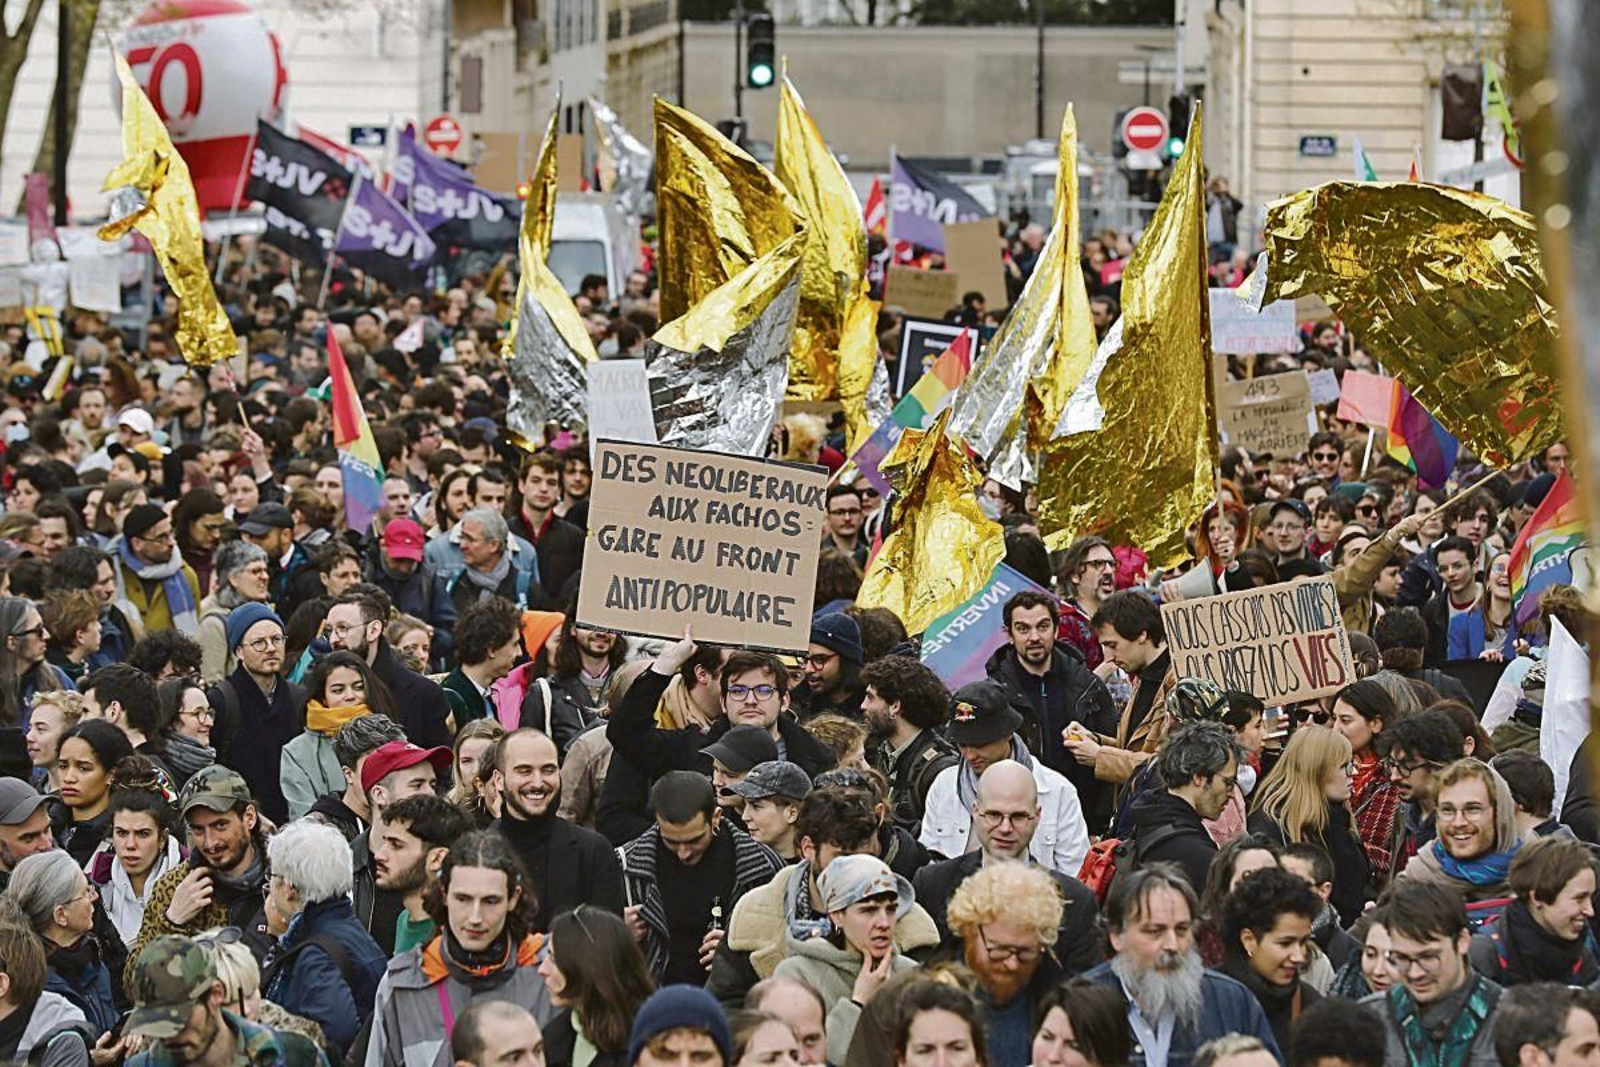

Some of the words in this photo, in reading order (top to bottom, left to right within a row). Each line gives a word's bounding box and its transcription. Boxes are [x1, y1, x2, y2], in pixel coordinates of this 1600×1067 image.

[1245, 379, 1280, 396] 493
[601, 451, 657, 483] DES
[665, 461, 826, 512] NEOLIBERAUX
[648, 495, 699, 523] AUX
[598, 525, 662, 558] GARE
[671, 536, 705, 563] AU
[716, 542, 800, 576] FRONT
[605, 575, 795, 627] ANTIPOPULAIRE
[1165, 603, 1209, 653] NOUS
[1210, 593, 1271, 646] CASSONS
[1270, 592, 1297, 636] DES
[1257, 639, 1300, 700] NOS
[1292, 632, 1346, 690] VIES
